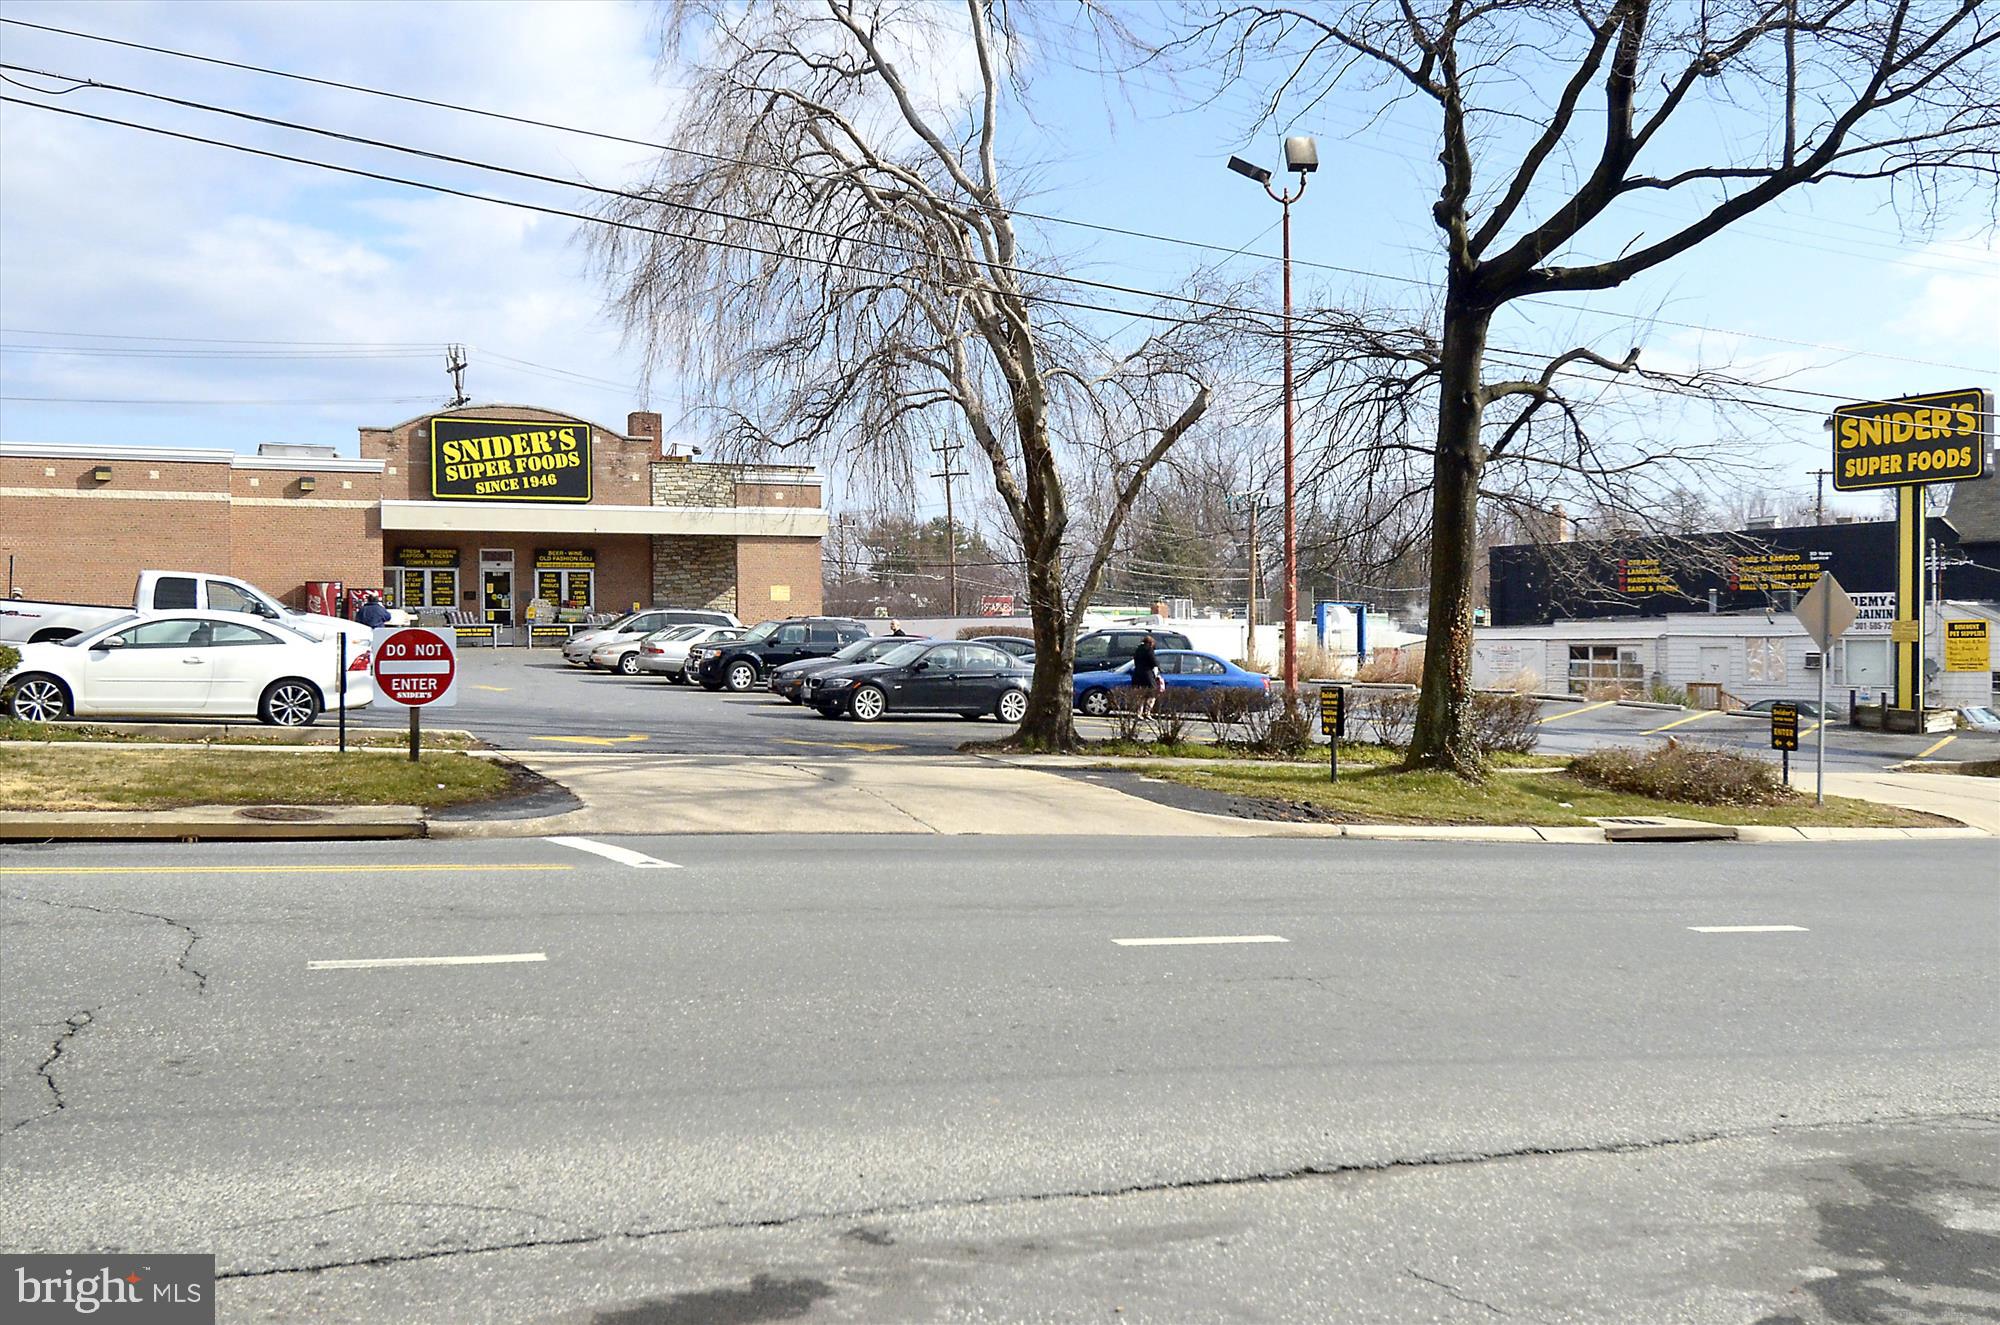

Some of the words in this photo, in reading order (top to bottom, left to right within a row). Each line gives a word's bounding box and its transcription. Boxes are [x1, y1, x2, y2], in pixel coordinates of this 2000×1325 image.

[1840, 403, 1976, 449] SNIDER'S
[442, 428, 577, 464] SNIDER'S
[445, 459, 513, 482] SUPER
[515, 451, 581, 473] FOODS
[1845, 454, 1902, 478] SUPER
[1907, 447, 1971, 472] FOODS
[475, 478, 519, 494] SINCE
[522, 473, 557, 489] 1946
[1850, 596, 1888, 606] DEMY
[1855, 609, 1893, 619] RAININ
[386, 644, 406, 656] DO
[415, 644, 443, 656] NOT
[391, 678, 438, 690] ENTER
[1774, 727, 1794, 736] ENTER
